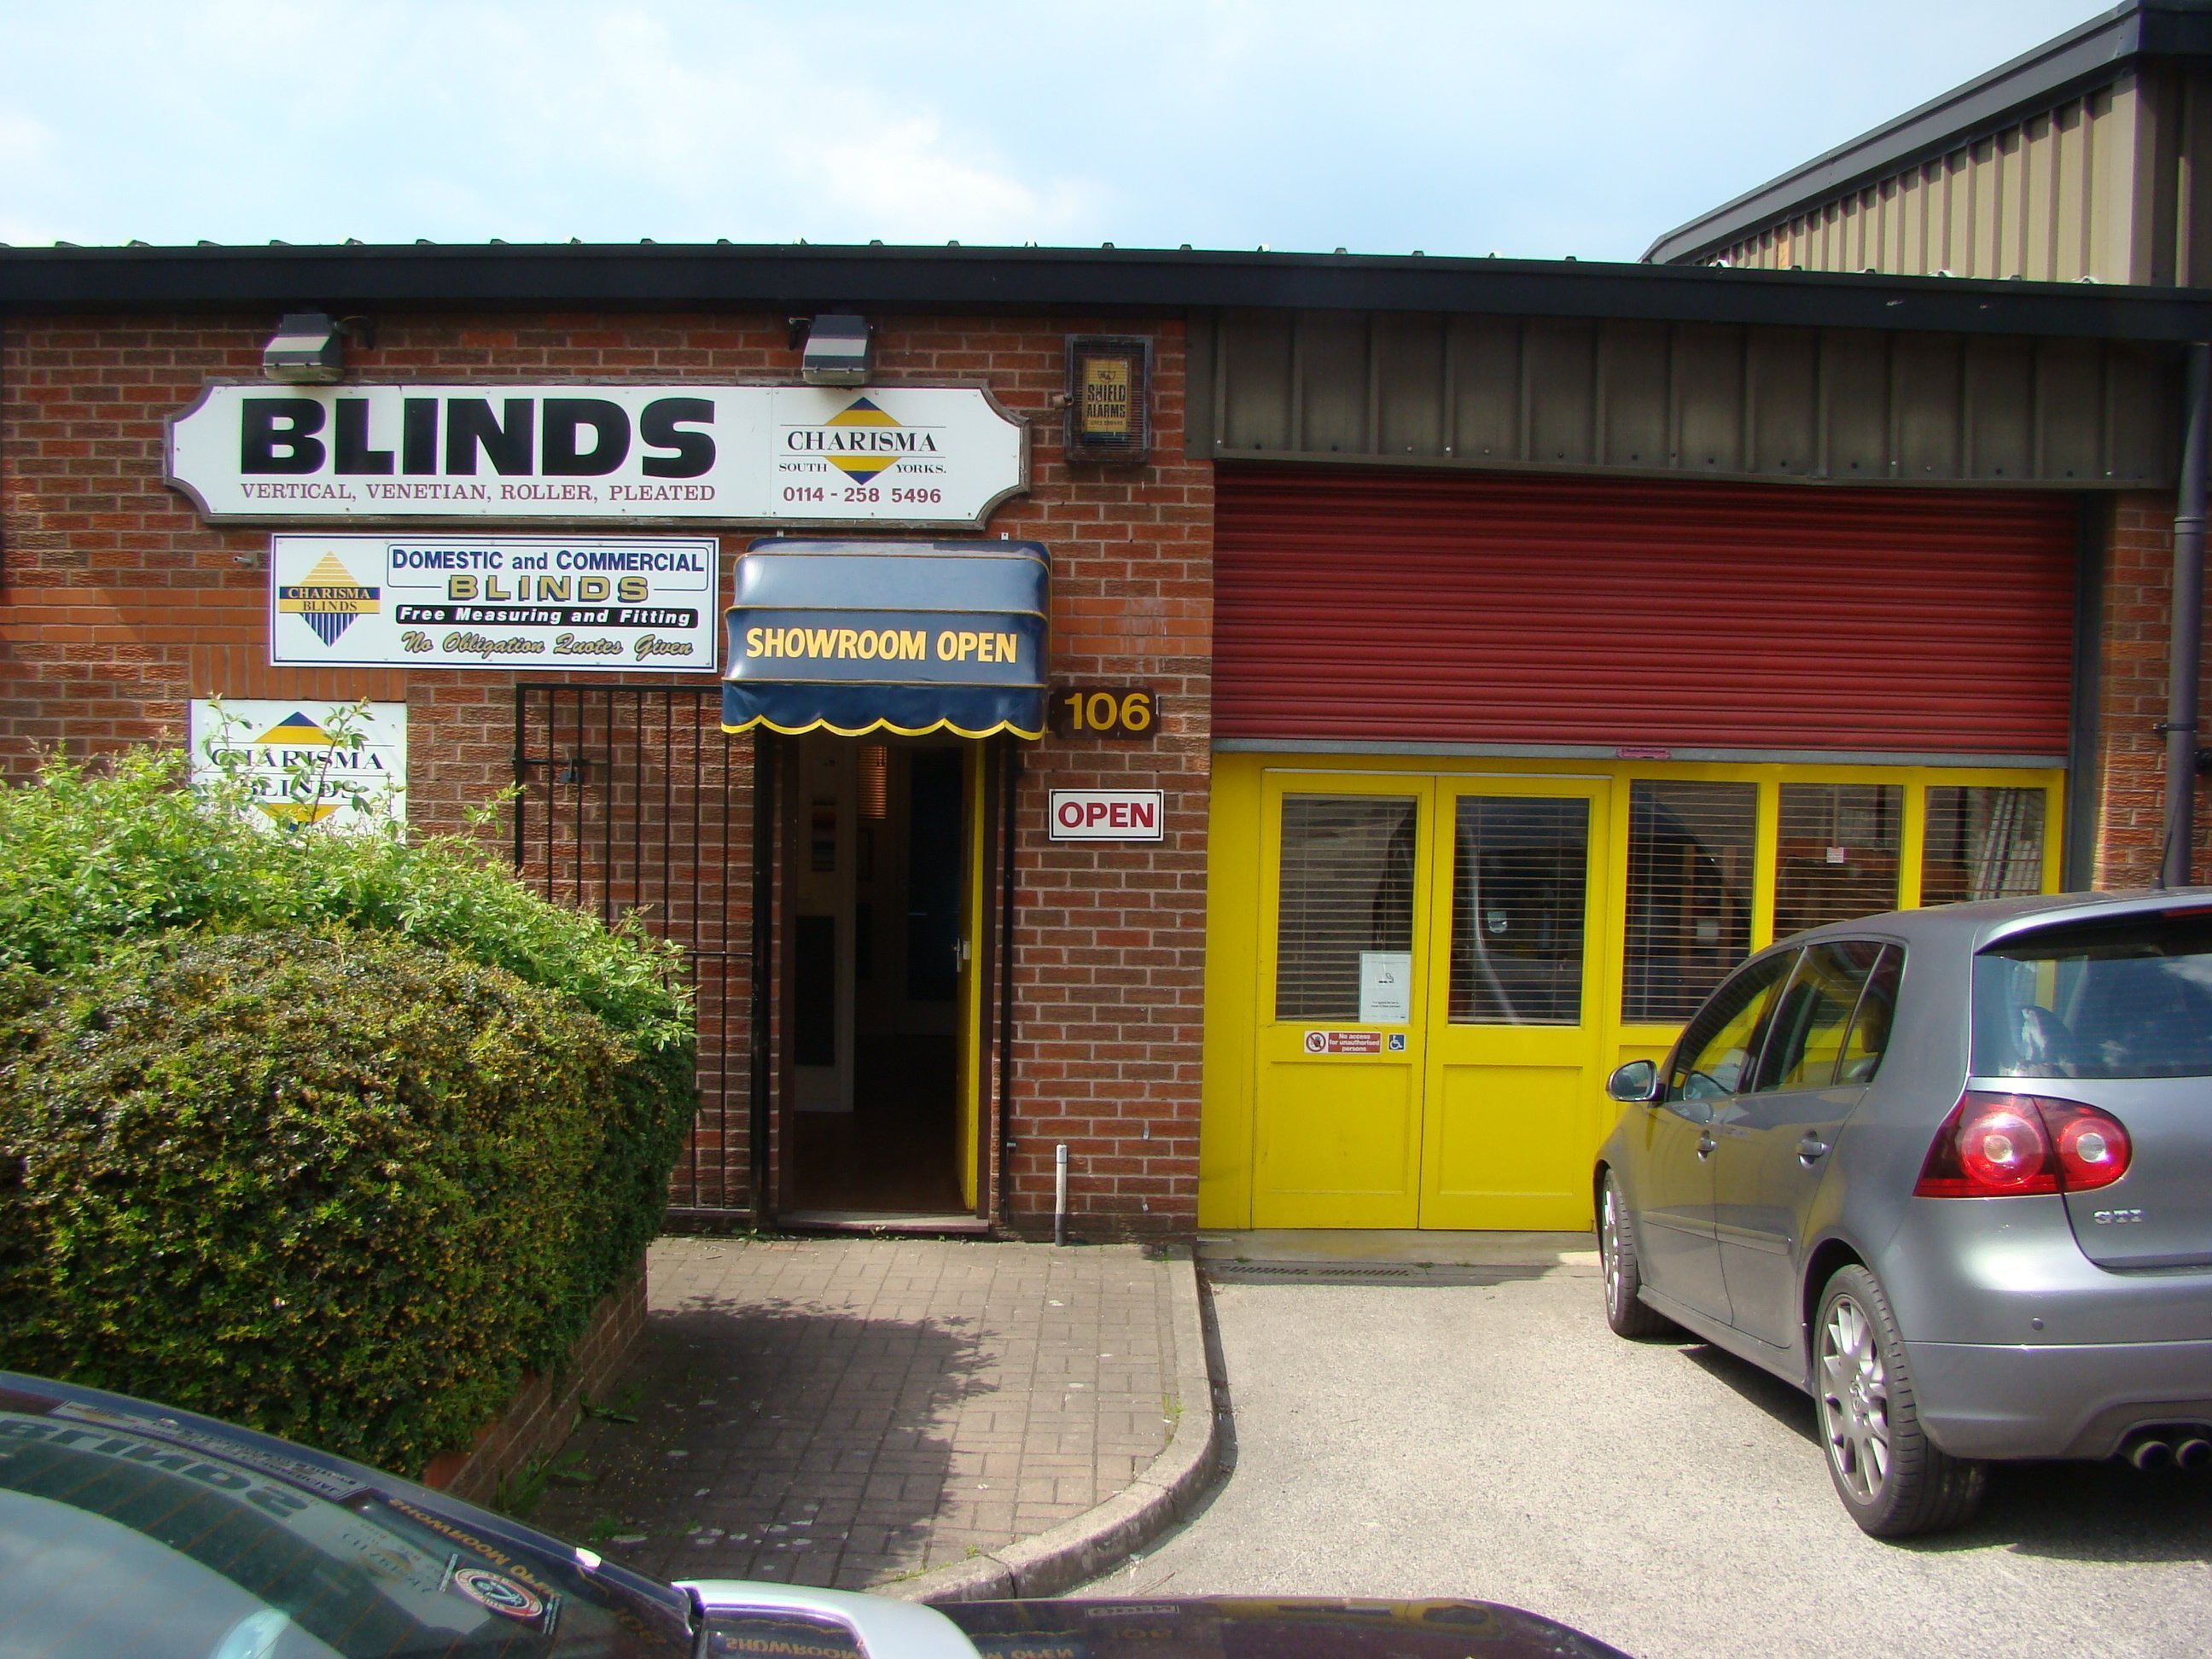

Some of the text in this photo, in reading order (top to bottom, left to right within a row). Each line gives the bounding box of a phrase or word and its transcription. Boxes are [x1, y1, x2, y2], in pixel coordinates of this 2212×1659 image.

[1087, 384, 1126, 402] SHIELD
[1087, 404, 1126, 418] ALARMS
[241, 398, 717, 479] BLINDS
[787, 431, 938, 452] CHARISMA
[778, 463, 947, 474] SOUTH YORKS.
[241, 483, 716, 504] VERTICAL, VENETIAN, ROLLER, PLEATED
[783, 486, 824, 502] 0114
[844, 487, 880, 503] 258
[891, 487, 942, 504] 5496
[392, 549, 705, 572] DOMESTIC and COMMERCIAL
[288, 587, 370, 599] CHARISMA
[448, 574, 649, 603] BLINDS
[303, 601, 358, 611] BLINDS
[399, 607, 690, 626] Free Measuring and Fitting
[401, 631, 694, 661] No Obligation Quotes Given
[745, 627, 1018, 663] SHOWROOM OPEN
[1064, 692, 1150, 731] 106
[1058, 801, 1154, 828] OPEN
[2093, 1209, 2142, 1224] GTI
